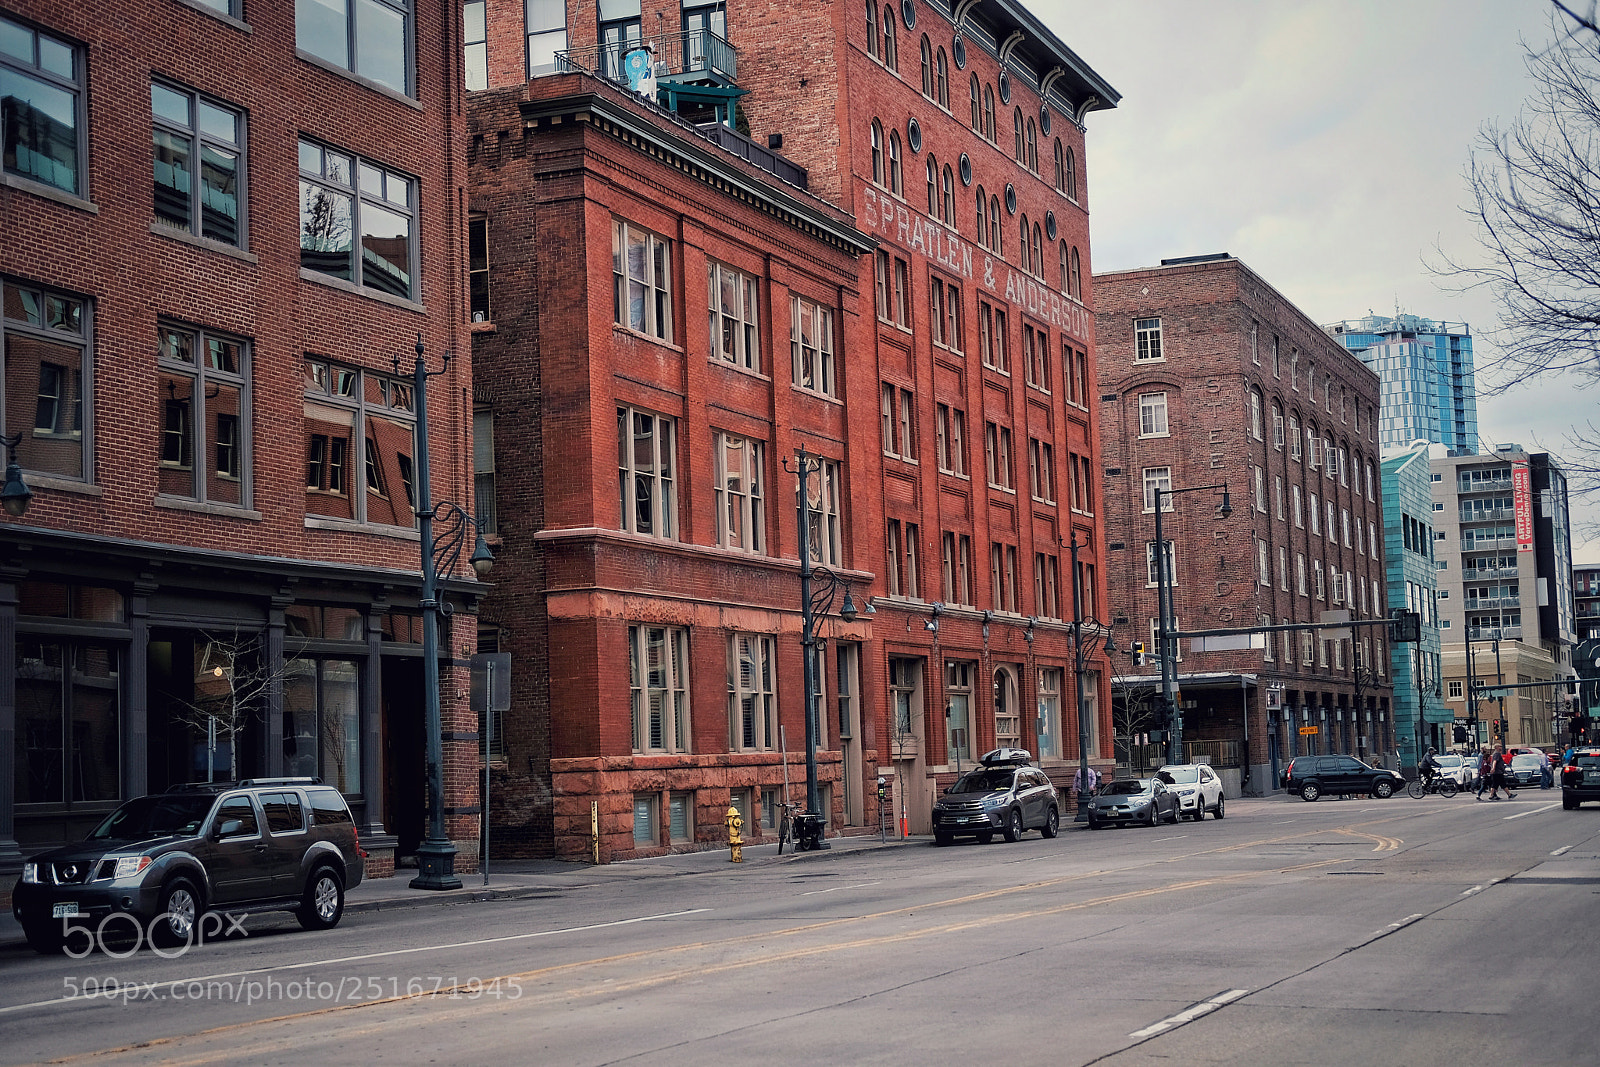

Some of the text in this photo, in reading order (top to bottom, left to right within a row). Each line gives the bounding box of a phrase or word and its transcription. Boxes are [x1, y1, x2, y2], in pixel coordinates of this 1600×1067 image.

[864, 187, 1090, 342] SPRATLEN & ANDERSON
[1514, 472, 1523, 504] LIVING
[1516, 505, 1525, 541] ARTFUL
